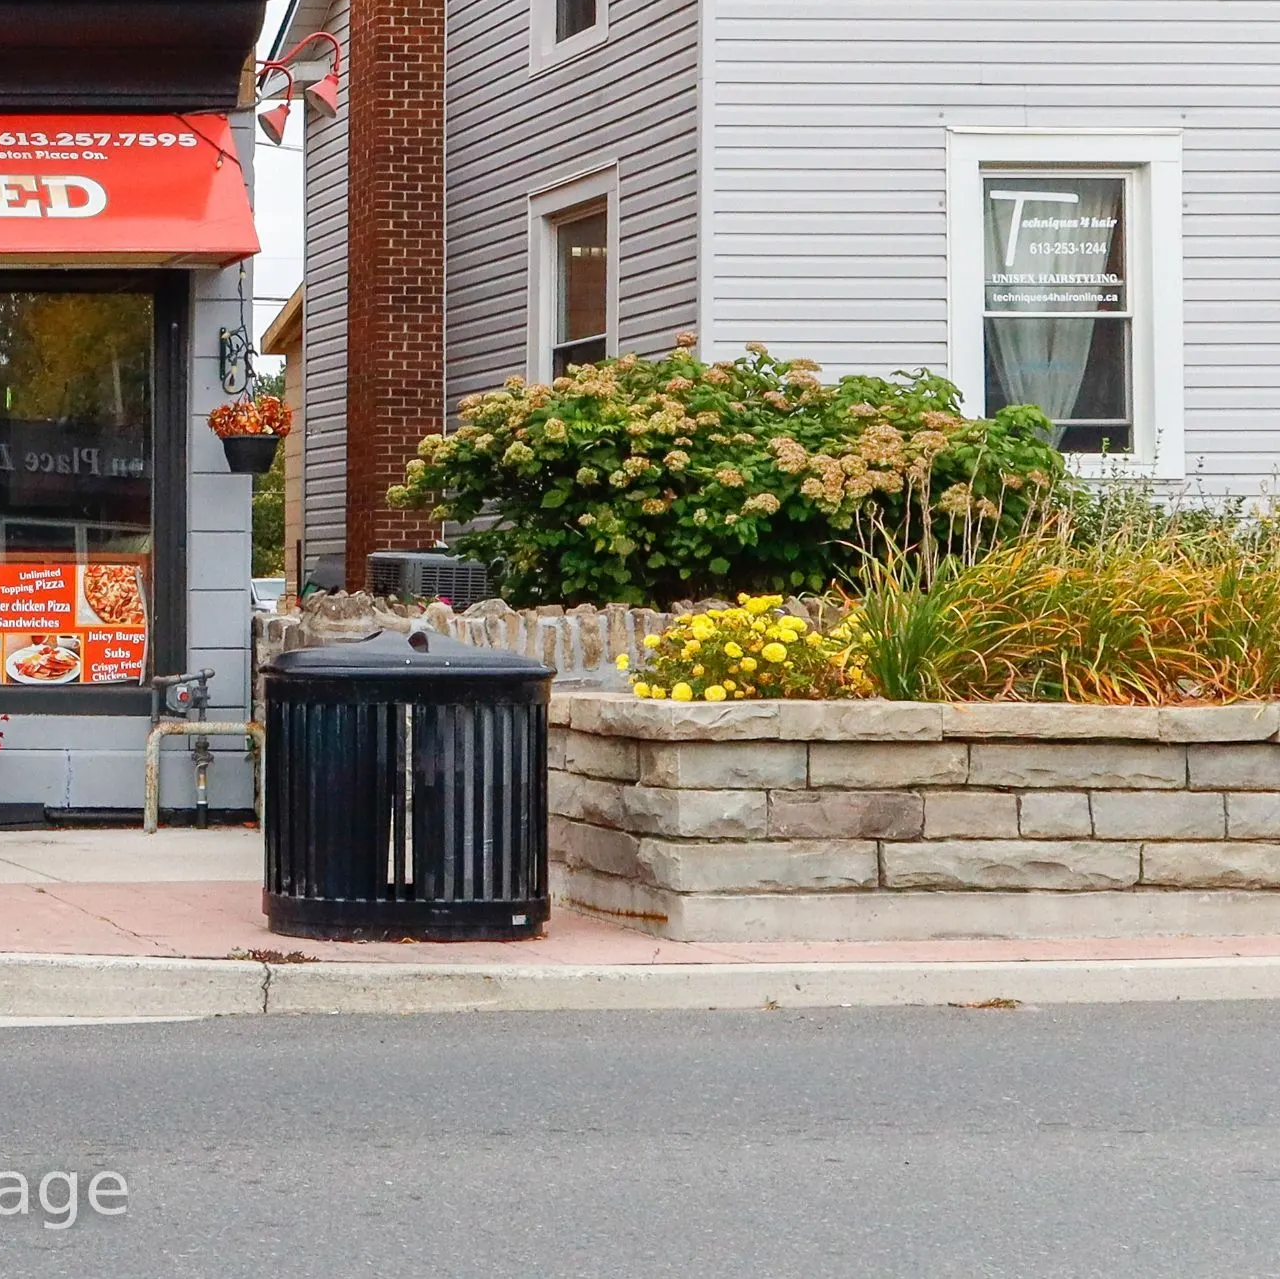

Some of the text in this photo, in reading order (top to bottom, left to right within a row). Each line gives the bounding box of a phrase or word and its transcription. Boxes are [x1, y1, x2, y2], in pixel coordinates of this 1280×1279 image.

[36, 149, 79, 161] Place
[82, 150, 109, 161] On.
[1090, 216, 1118, 228] hair
[1029, 241, 1108, 255] 613-253-1244
[992, 273, 1118, 284] UNISEX HAIRSTYLING
[993, 292, 1119, 304] techniques4haironline.ca
[19, 568, 61, 580] Unlimited
[0, 579, 65, 596] Topping Pizza
[11, 599, 45, 612] chicken
[47, 600, 71, 612] Pizza
[88, 630, 145, 644] Juicy Burge
[105, 647, 130, 659] Subs
[91, 660, 142, 673] Crispy Fried
[92, 671, 128, 681] Chicken
